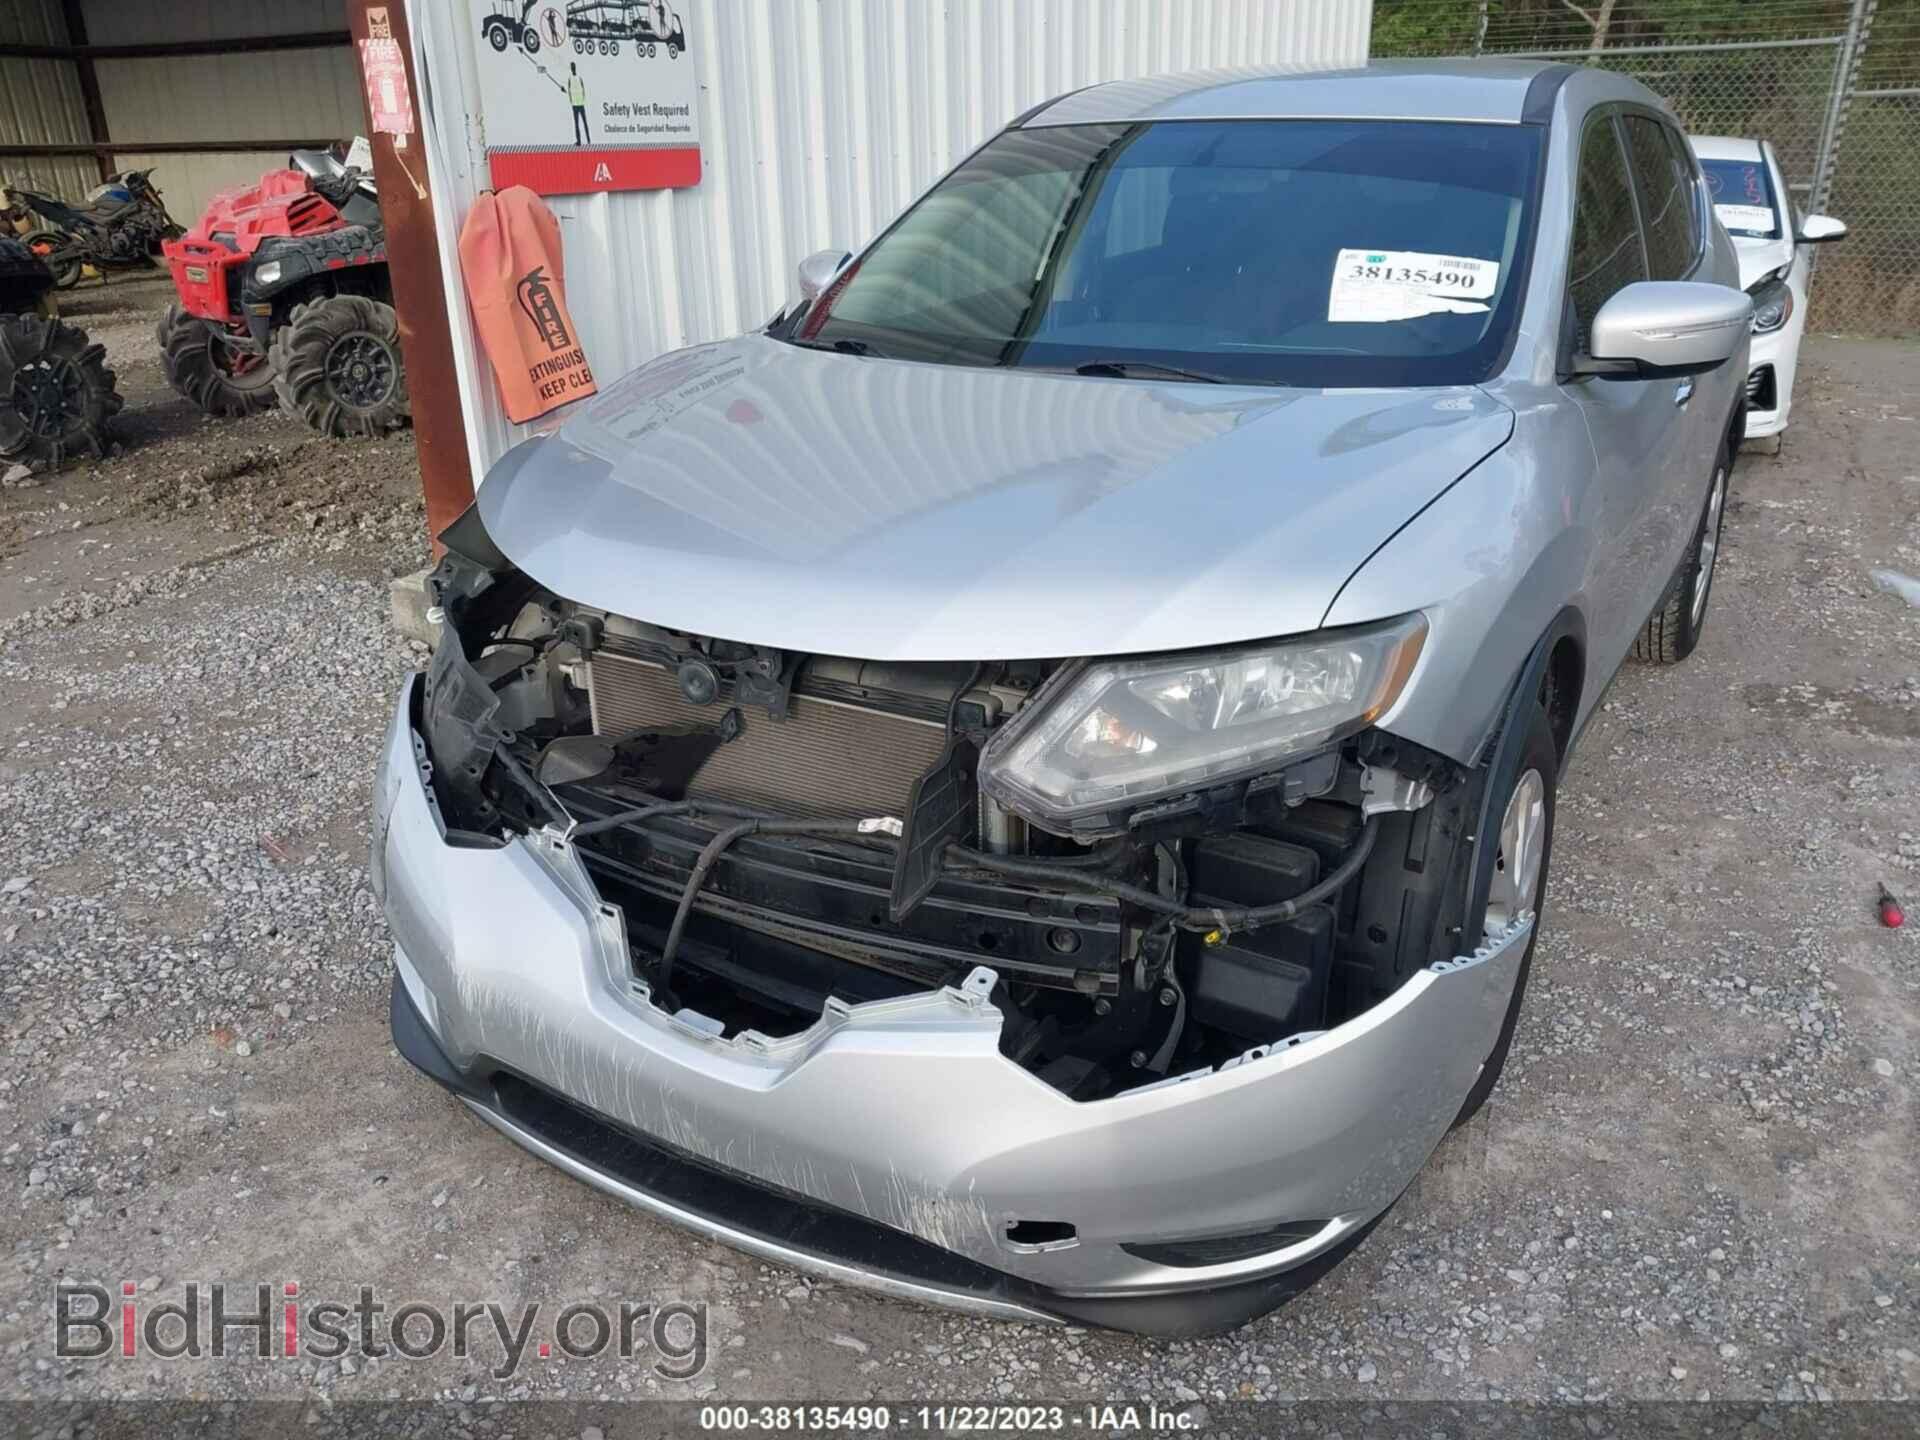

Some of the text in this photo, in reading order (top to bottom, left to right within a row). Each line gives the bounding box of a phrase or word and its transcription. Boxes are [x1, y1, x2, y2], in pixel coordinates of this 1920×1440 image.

[602, 102, 689, 118] Safety Vest Required
[1348, 264, 1475, 289] 38135490
[533, 292, 566, 347] FIRE
[539, 378, 566, 401] KEEP
